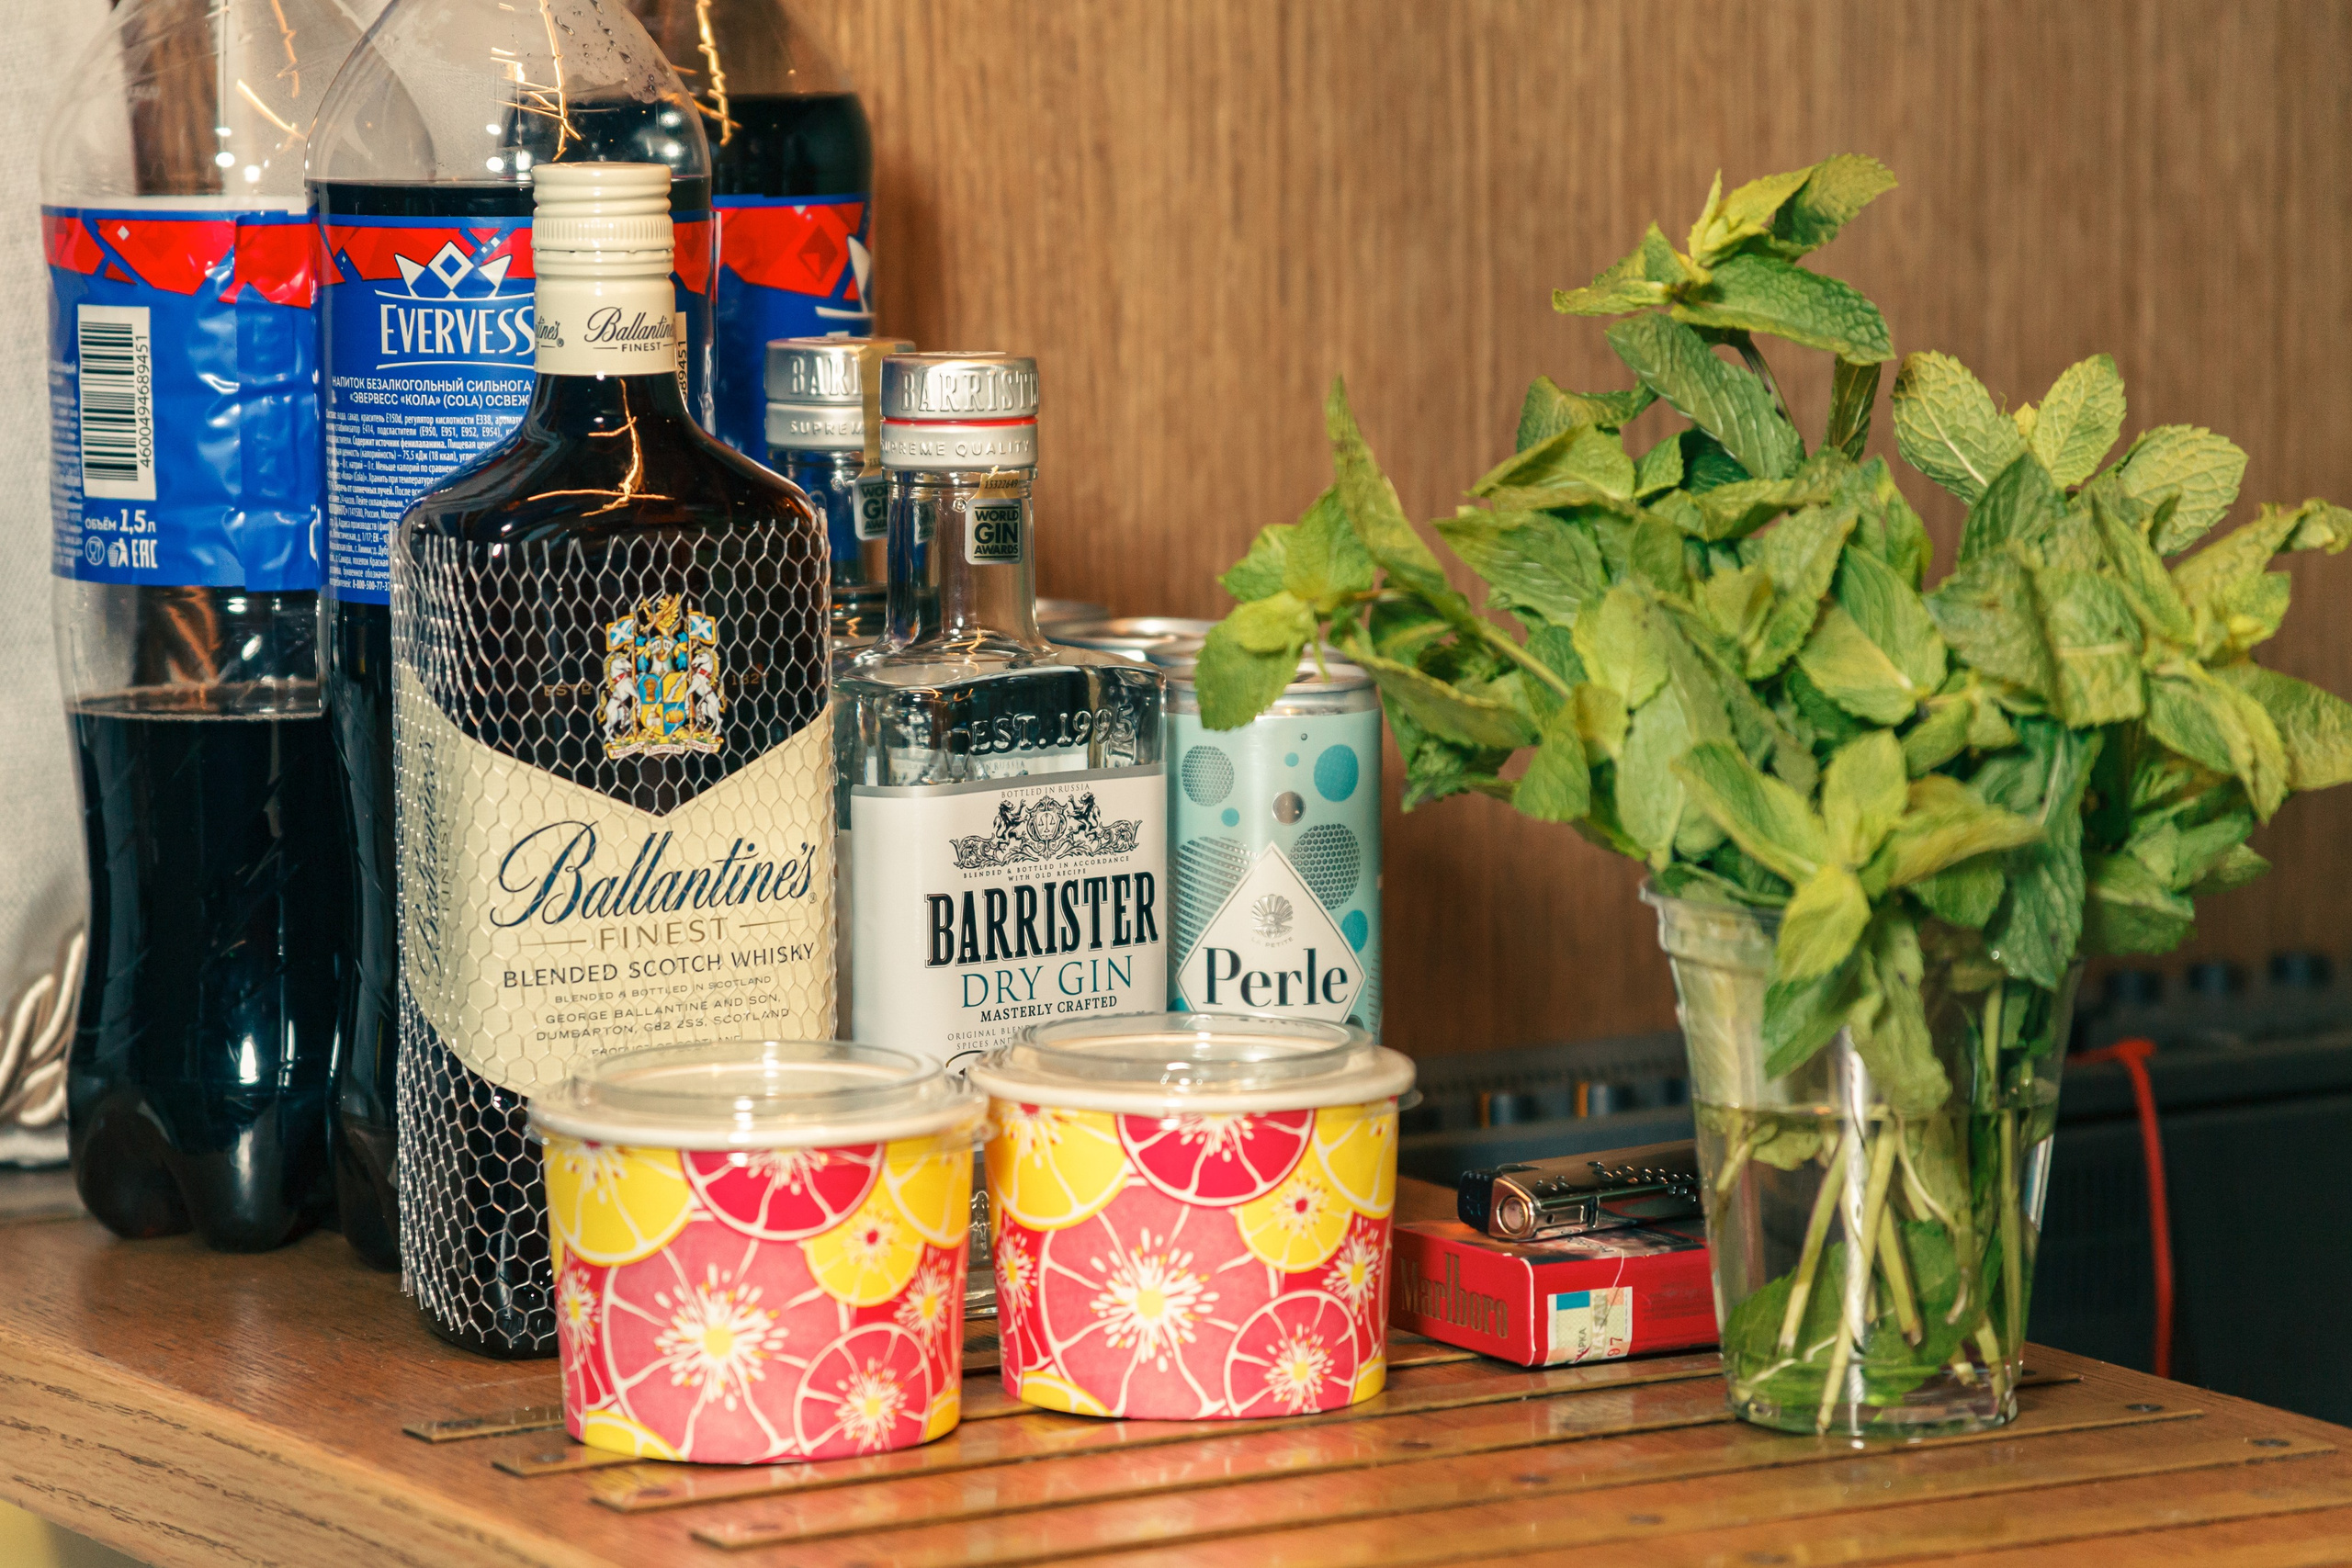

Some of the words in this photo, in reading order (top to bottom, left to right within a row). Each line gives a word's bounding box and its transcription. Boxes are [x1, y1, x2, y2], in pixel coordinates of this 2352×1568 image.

[380, 303, 535, 355] EVERVESS
[621, 342, 662, 353] FINEST
[332, 376, 365, 389] НАПИТОК
[367, 378, 463, 392] БЕЗАЛКОГОЛЬНЫЙ
[135, 335, 152, 468] 4600494689451
[401, 393, 441, 406] «КОЛА»
[404, 415, 434, 427] регулятор
[435, 415, 474, 425] кислотности
[378, 426, 416, 437] подсластители
[375, 438, 400, 447] источник
[447, 438, 476, 450] Пищевая
[955, 439, 1031, 457] QUALITY
[85, 516, 117, 530] ОБЪЁМ
[975, 511, 1018, 522] WORLD
[974, 523, 1018, 544] GIN
[974, 545, 1018, 555] AWARDS
[970, 713, 1046, 755] EST.
[1001, 786, 1042, 798] BOTTLED
[1045, 785, 1056, 795] IN
[1057, 783, 1091, 794] RUSSIA
[490, 819, 816, 928] Ballantine's
[964, 870, 1004, 879] BLENDED
[1016, 863, 1054, 874] BOTTLED
[1059, 861, 1069, 869] IN
[1073, 855, 1130, 867] ACCORDANCE
[1008, 874, 1031, 883] WITH
[1035, 871, 1052, 880] OLD
[1057, 867, 1086, 877] RECIPE
[924, 871, 1159, 969] BARRISTER
[599, 918, 729, 951] FINEST
[1264, 936, 1294, 948] PETITE
[503, 964, 618, 988] BLENDED
[628, 953, 721, 976] SCOTCH
[731, 942, 816, 968] WHISKY
[961, 964, 1044, 1008] DRY
[1058, 954, 1133, 996] GIN
[1202, 946, 1350, 1008] Perle
[555, 991, 614, 1003] BLENDED
[632, 985, 688, 998] BOTTLED
[708, 976, 772, 989] SCOTLAND
[546, 1010, 608, 1024] GEORGE
[615, 1000, 708, 1019] BALLANTINE
[714, 997, 743, 1009] AND
[749, 993, 781, 1007] SON,
[713, 1008, 789, 1025] SCOTLAND
[980, 1003, 1053, 1023] MASTERLY
[1057, 996, 1117, 1013] CRAFTED
[947, 1028, 996, 1042] ORIGINAL
[956, 1039, 989, 1052] SPICES
[1400, 1251, 1509, 1338] Marlboro
[1607, 1337, 1623, 1357] 97
